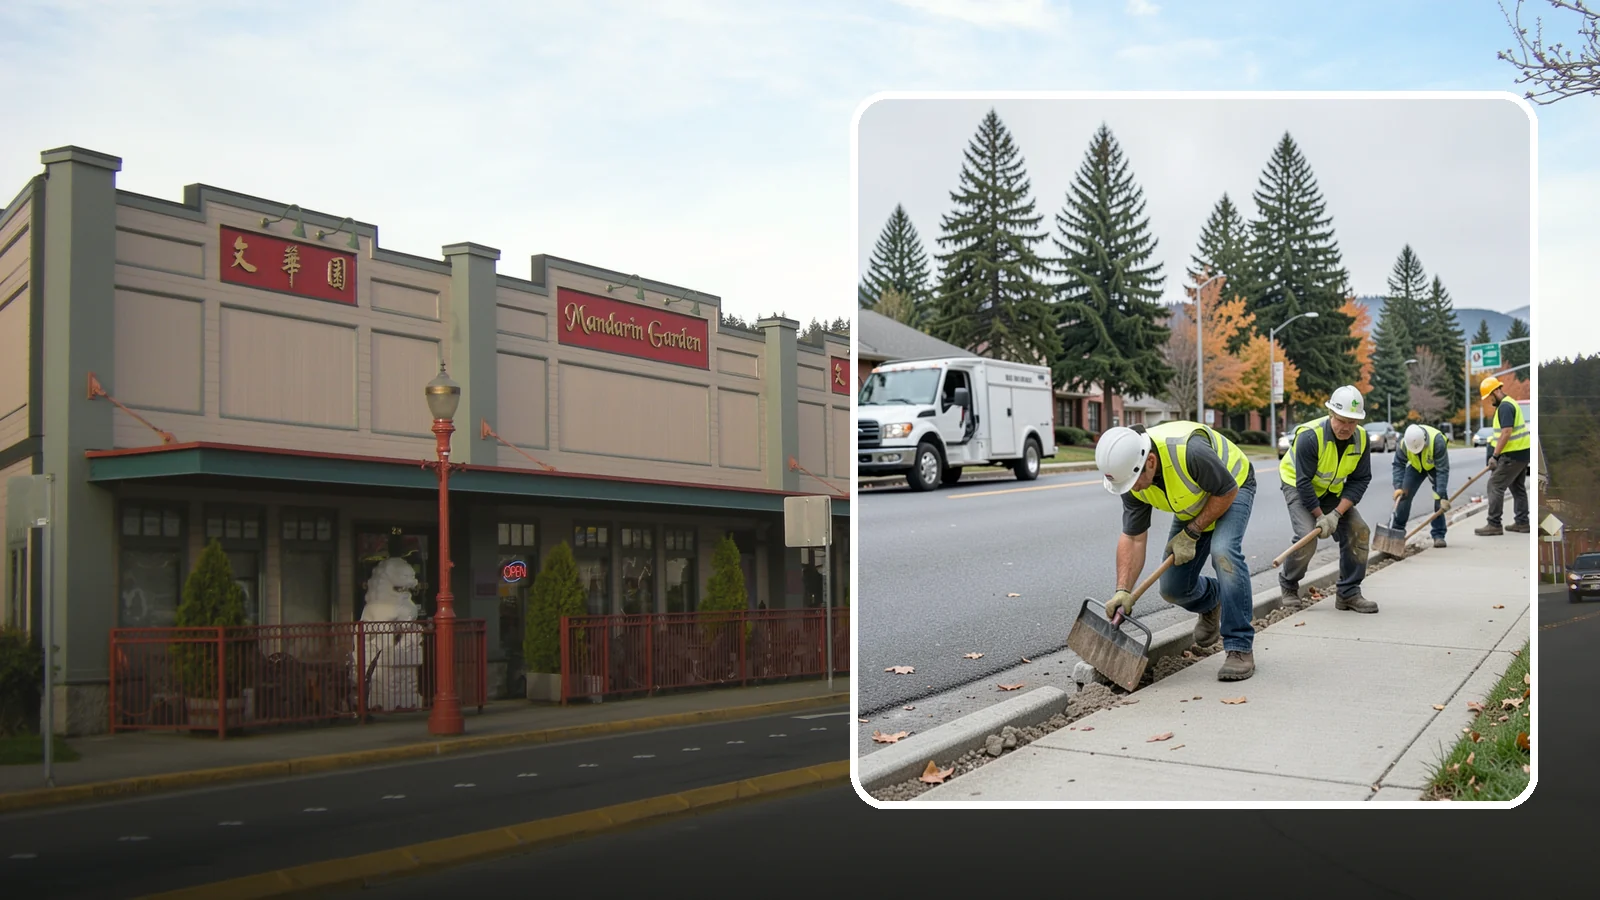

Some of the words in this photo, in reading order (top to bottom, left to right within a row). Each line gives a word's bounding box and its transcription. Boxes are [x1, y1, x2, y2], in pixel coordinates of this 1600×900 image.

[231, 235, 346, 291] 文華園
[564, 302, 644, 341] Mandarin
[648, 320, 702, 352] Garden
[503, 565, 527, 578] OPEN
